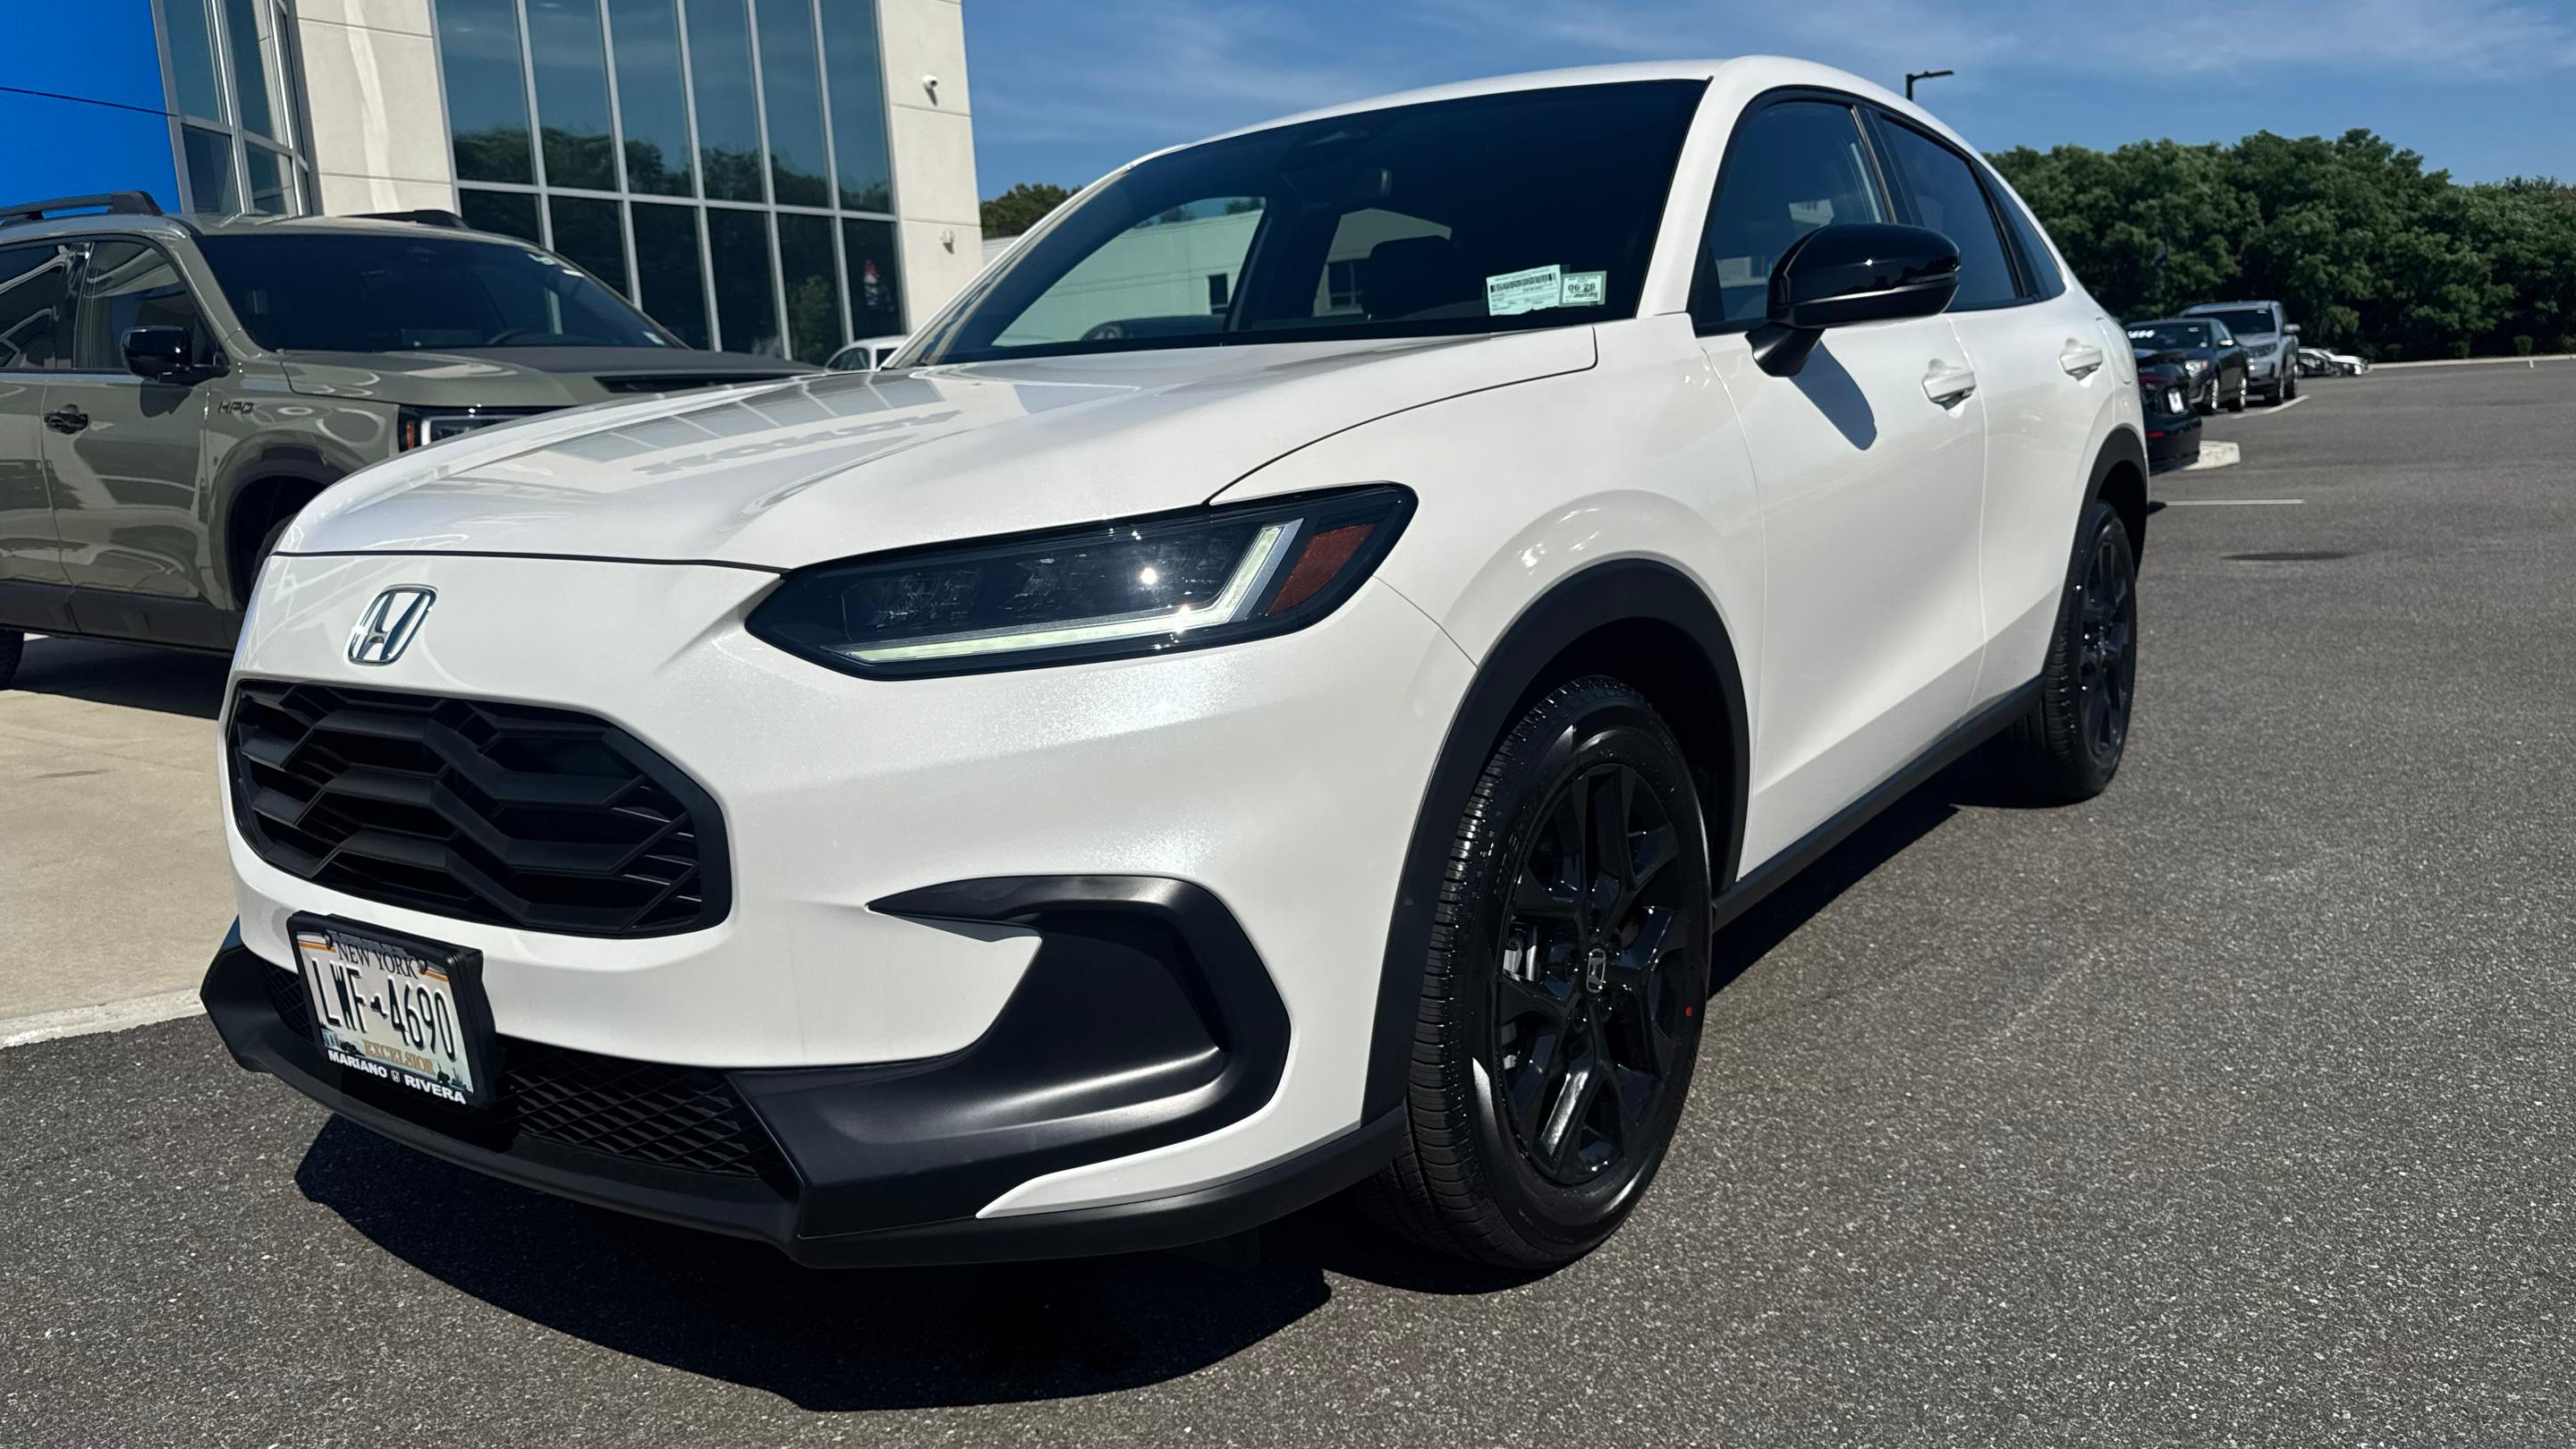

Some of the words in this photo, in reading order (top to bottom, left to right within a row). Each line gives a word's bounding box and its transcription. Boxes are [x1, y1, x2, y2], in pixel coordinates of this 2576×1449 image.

[337, 942, 370, 967] NEW
[375, 951, 419, 979] YORK
[362, 1039, 433, 1073] EXCELSIOR
[327, 1050, 387, 1079] MARIANO
[404, 1074, 467, 1105] RIVERA
